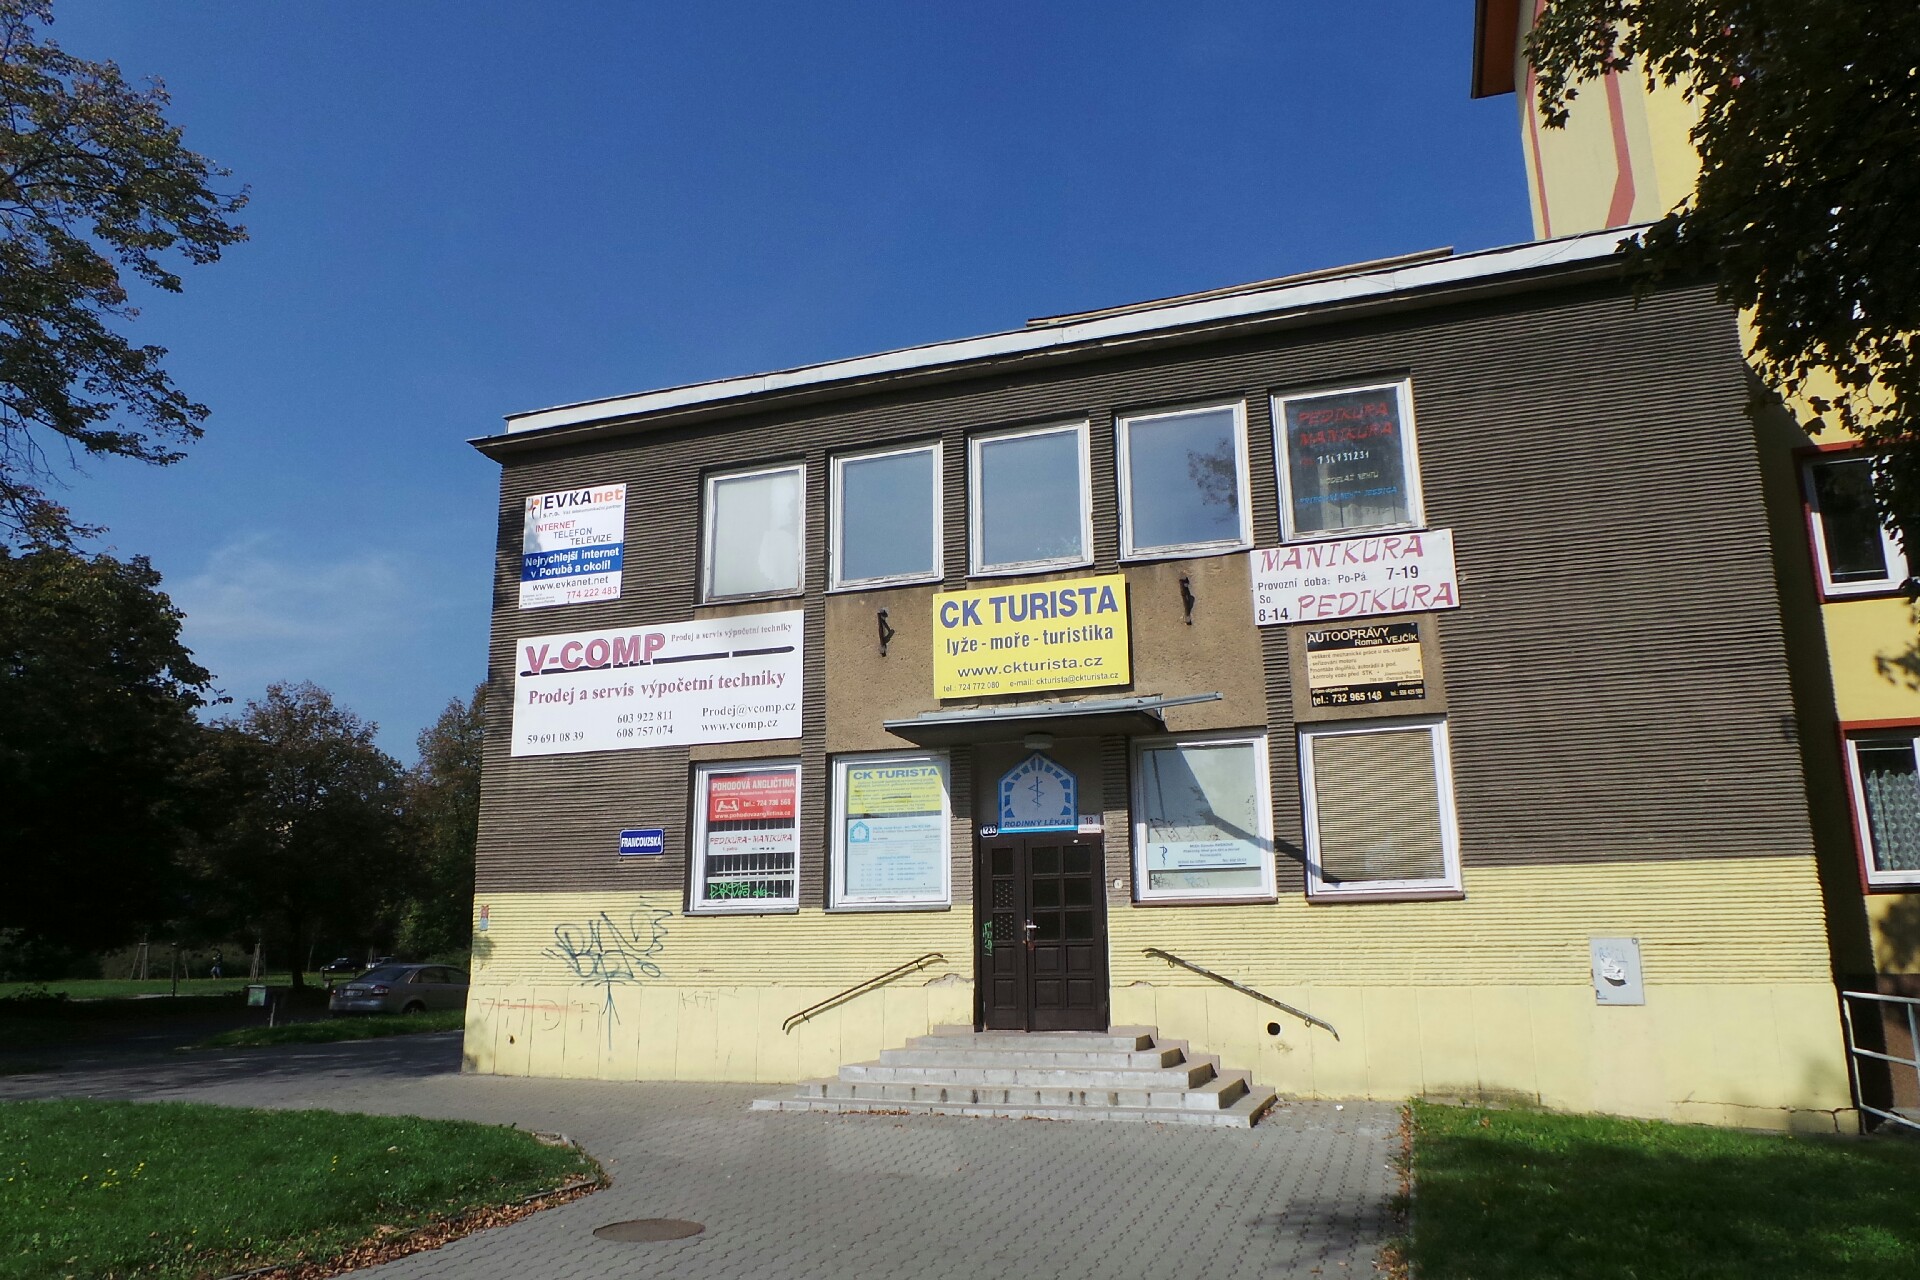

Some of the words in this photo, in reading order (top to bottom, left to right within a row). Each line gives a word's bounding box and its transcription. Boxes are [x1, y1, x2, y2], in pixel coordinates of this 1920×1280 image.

[544, 488, 623, 510] EVKAnet
[535, 520, 576, 533] INTERNET
[553, 527, 593, 539] TELEFON
[570, 533, 612, 546] TELEVIZE
[525, 551, 578, 567] Nejrychlejší
[582, 547, 620, 560] internet
[540, 564, 573, 577] Porubě
[532, 576, 609, 591] www.evkanet.net
[1258, 577, 1297, 591] Provozní
[1304, 576, 1330, 587] doba:
[1386, 565, 1419, 580] 7-19
[566, 590, 581, 599] 774
[584, 587, 599, 598] 222
[602, 586, 618, 596] 483
[940, 598, 983, 629] CK
[989, 585, 1118, 624] TURISTA
[671, 632, 694, 642] Prodej
[702, 630, 723, 639] servis
[724, 625, 759, 638] výpočetní
[761, 623, 793, 633] techniky
[946, 637, 978, 656] lyže
[990, 632, 1030, 650] moře
[1043, 624, 1113, 645] turistika
[1354, 638, 1383, 646] Roman
[525, 633, 666, 673] V-COMP
[957, 657, 1103, 677] www.ckturista.cz
[528, 687, 575, 705] Prodej
[579, 689, 587, 700] a
[592, 682, 634, 699] servis
[641, 674, 714, 698] výpočetní
[718, 670, 786, 689] techniky
[959, 682, 971, 691] 724
[973, 681, 985, 690] 772
[1009, 678, 1034, 688] e-mail:
[1036, 672, 1119, 685] ckturista@ckturista.cz
[1312, 695, 1329, 706] tel.:
[1332, 694, 1348, 703] 732
[1350, 692, 1365, 701] 965
[617, 713, 634, 724] 603
[637, 712, 654, 722] 922
[656, 710, 672, 721] 811
[702, 703, 796, 717] Prodej@vcomp.cz
[616, 728, 634, 738] 608
[637, 726, 654, 737] 757
[656, 724, 673, 735] 074
[701, 719, 778, 731] www.vcomp.cz
[527, 734, 538, 745] 59
[540, 733, 555, 744] 691
[559, 732, 570, 742] 08
[572, 731, 584, 741] 39
[853, 771, 873, 780] CK
[876, 768, 938, 778] TURISTA
[712, 778, 751, 792] POHODOVÁ
[752, 777, 795, 789] ANGLIČTINA
[1085, 816, 1093, 824] 18
